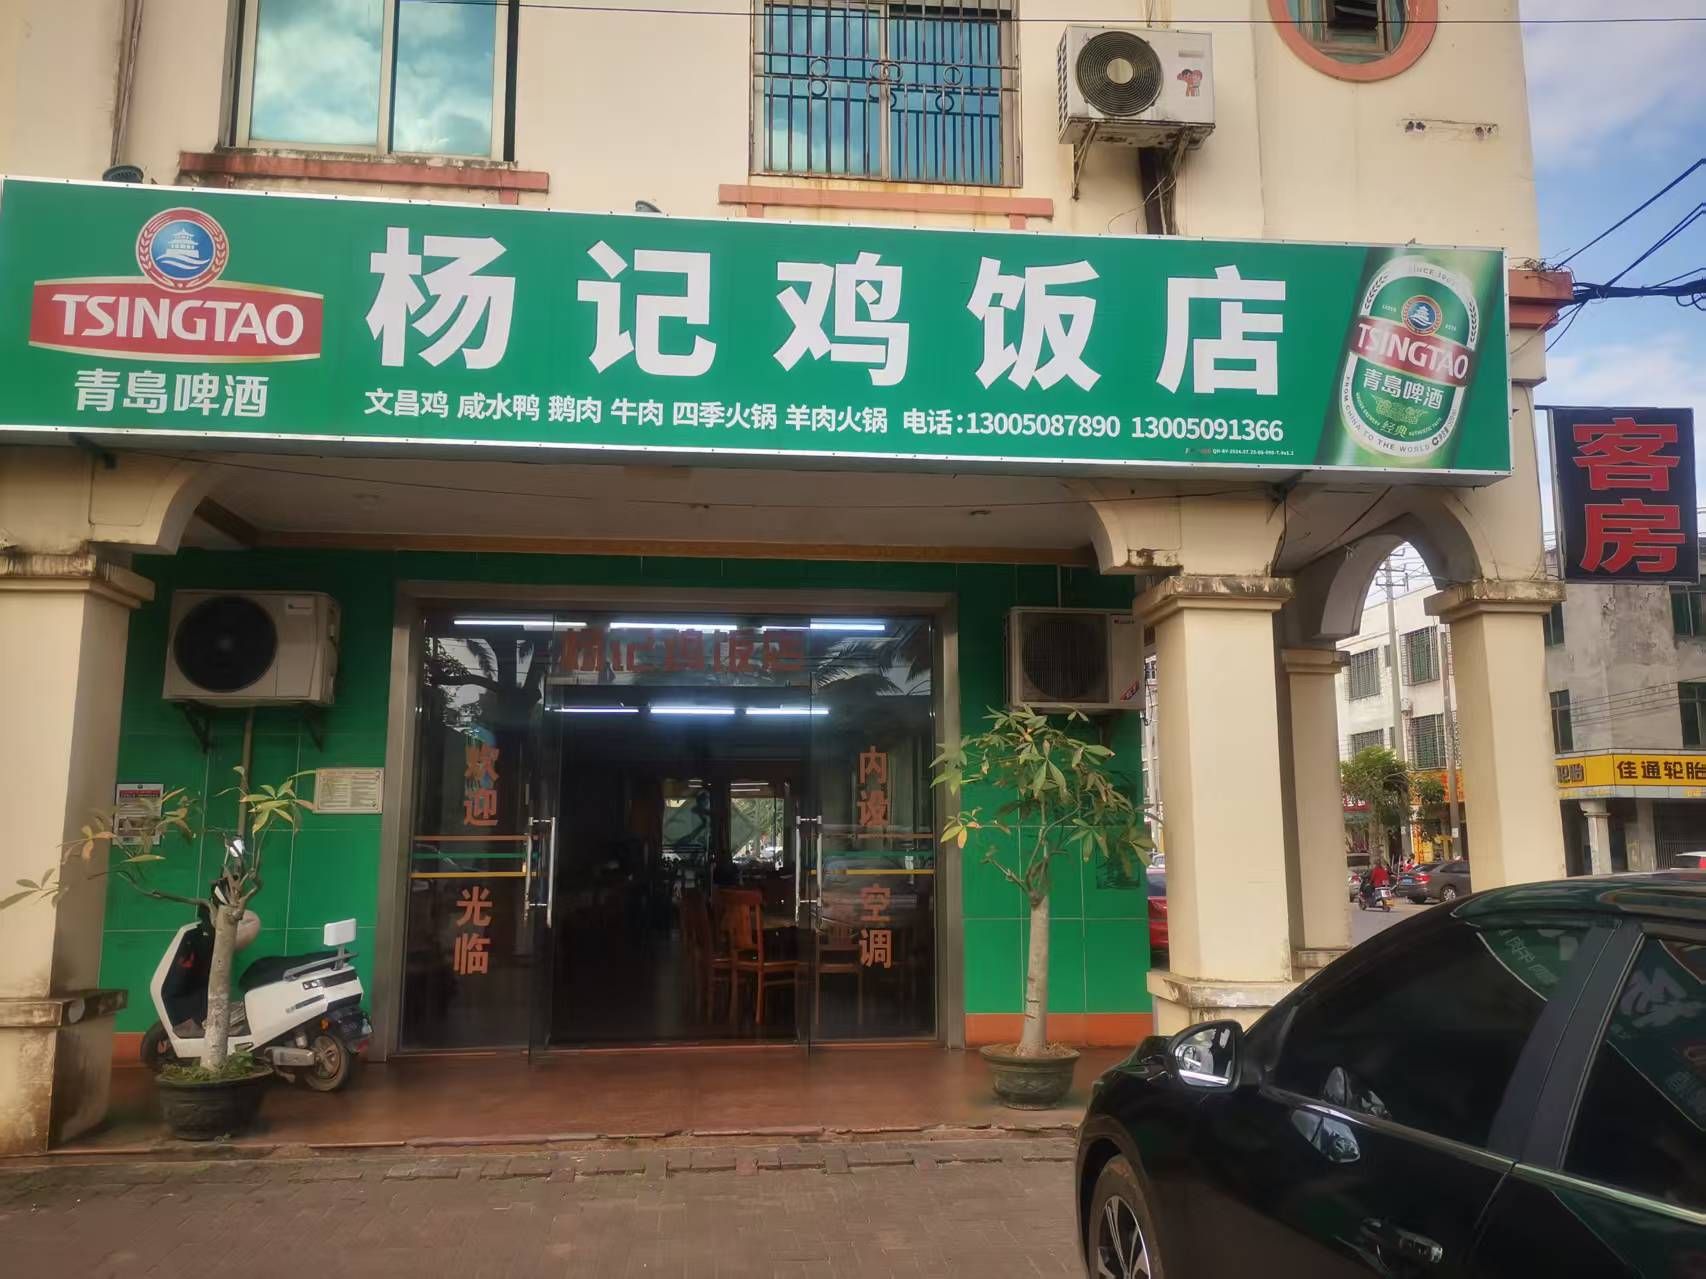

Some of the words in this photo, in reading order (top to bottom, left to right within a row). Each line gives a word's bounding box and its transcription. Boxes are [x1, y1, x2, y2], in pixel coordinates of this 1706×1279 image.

[52, 293, 304, 346] TSINGTAO
[365, 226, 1286, 396] 杨记鸡饭店
[1357, 323, 1470, 380] TSINGTAO
[364, 387, 449, 418] 文昌鸡
[457, 391, 540, 421] 咸水鸭
[548, 394, 602, 424] 鹅肉
[611, 397, 664, 426] 牛肉
[673, 401, 777, 430] 四季火锅
[785, 404, 888, 433] 羊肉火锅
[1131, 416, 1284, 441] 13005091366
[1572, 417, 1686, 573] 客房
[1616, 760, 1706, 781] 佳通轮胎
